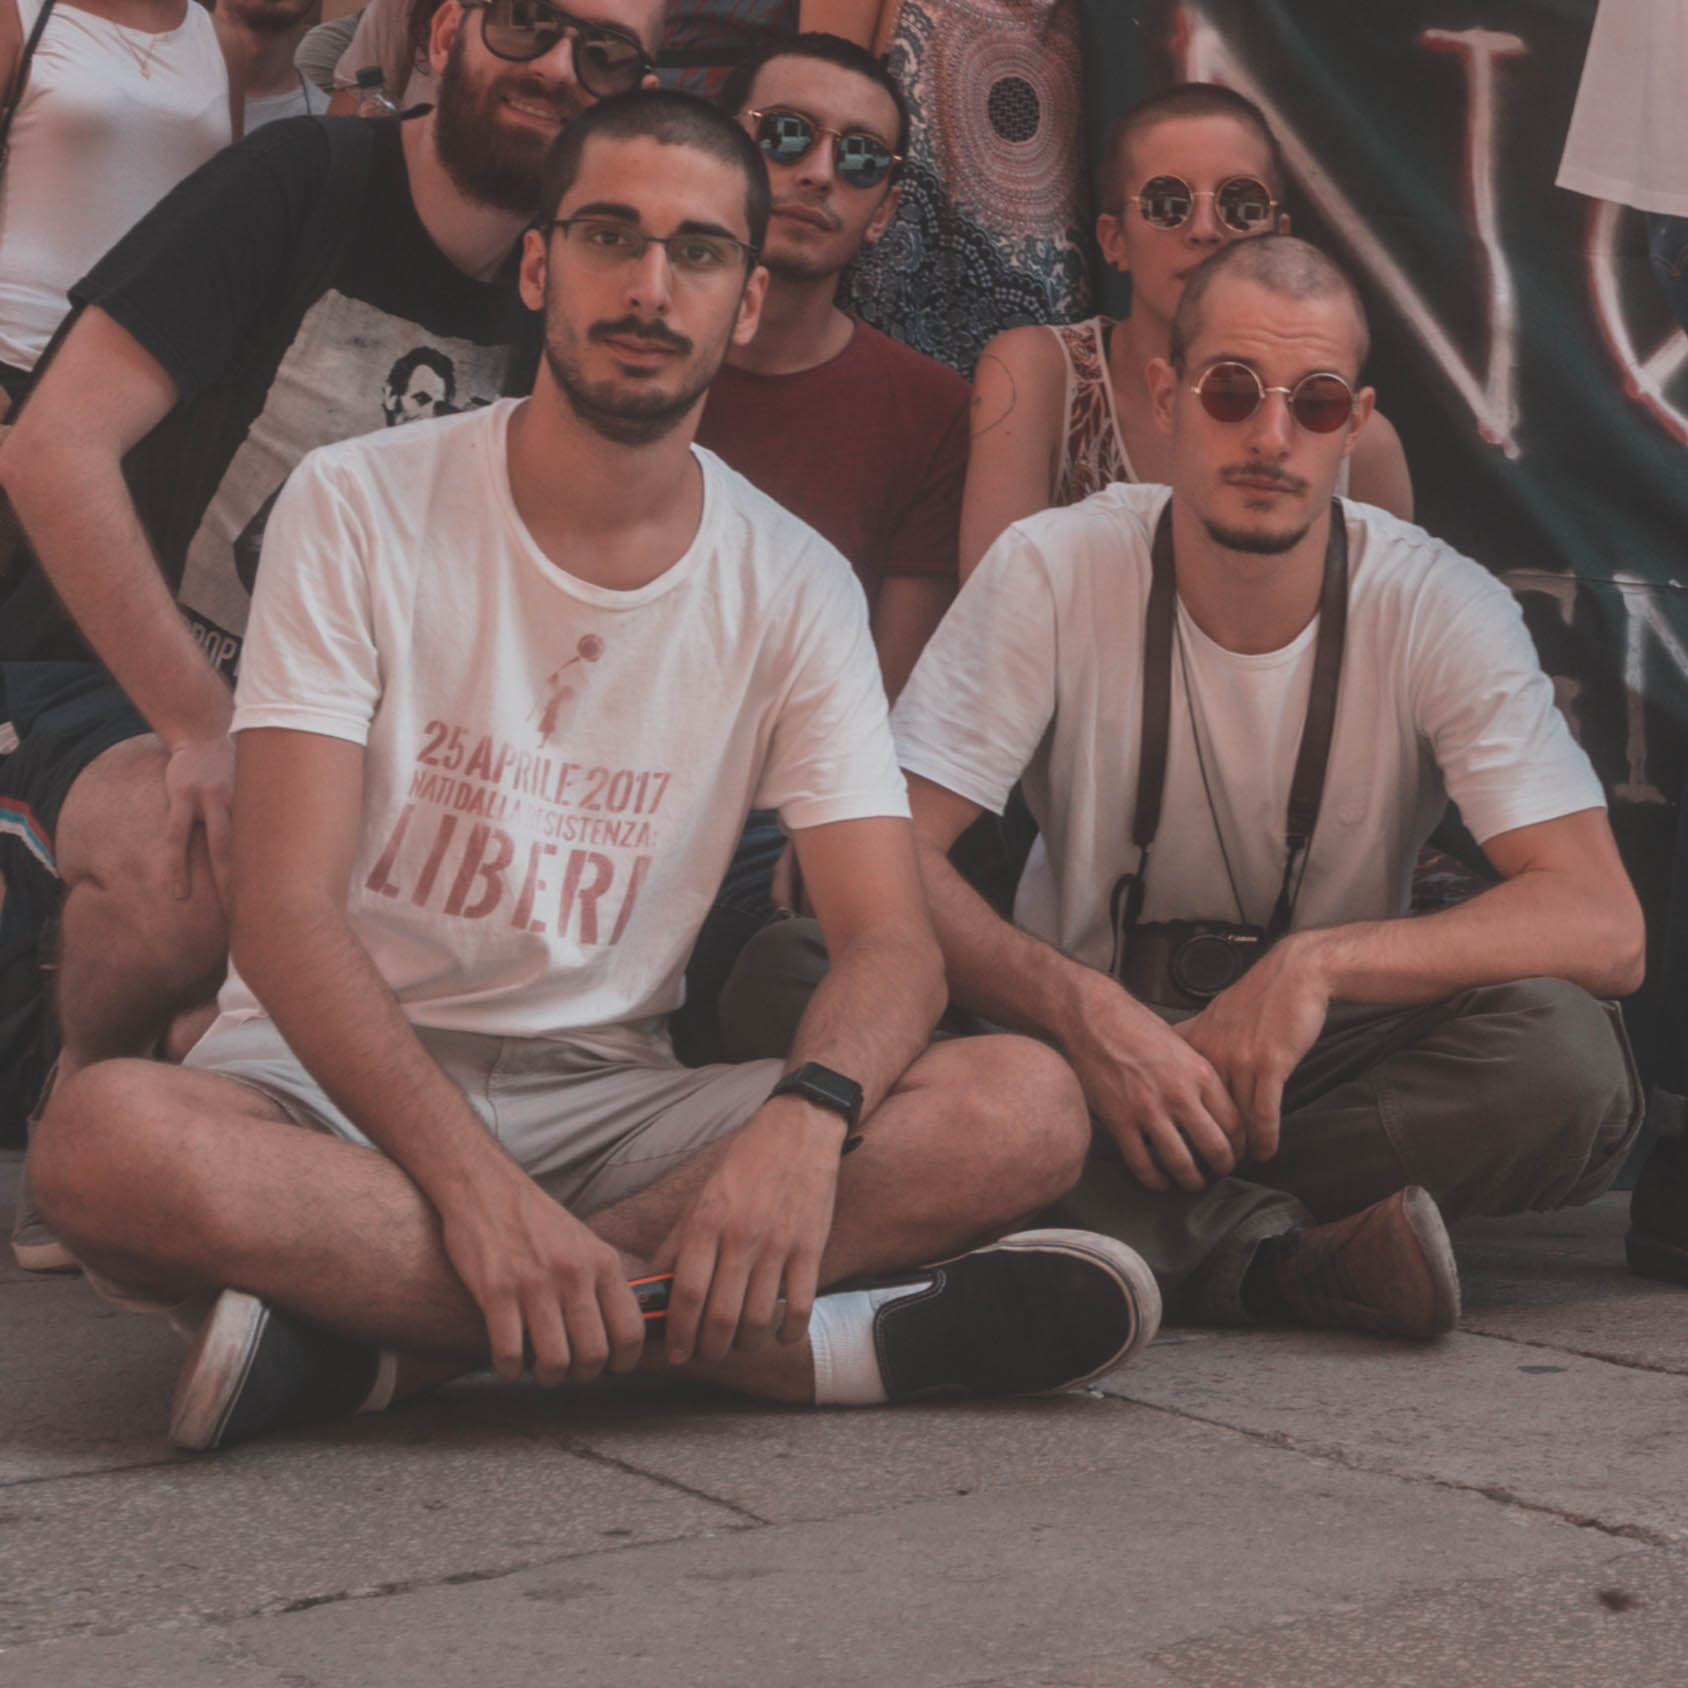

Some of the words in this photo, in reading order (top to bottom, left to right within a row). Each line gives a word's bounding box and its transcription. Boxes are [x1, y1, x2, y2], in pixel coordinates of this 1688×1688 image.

[407, 769, 453, 805] NATI
[416, 720, 470, 771] 25
[465, 734, 583, 807] APRILE
[577, 762, 672, 815] 2017
[364, 802, 653, 946] LIBERI
